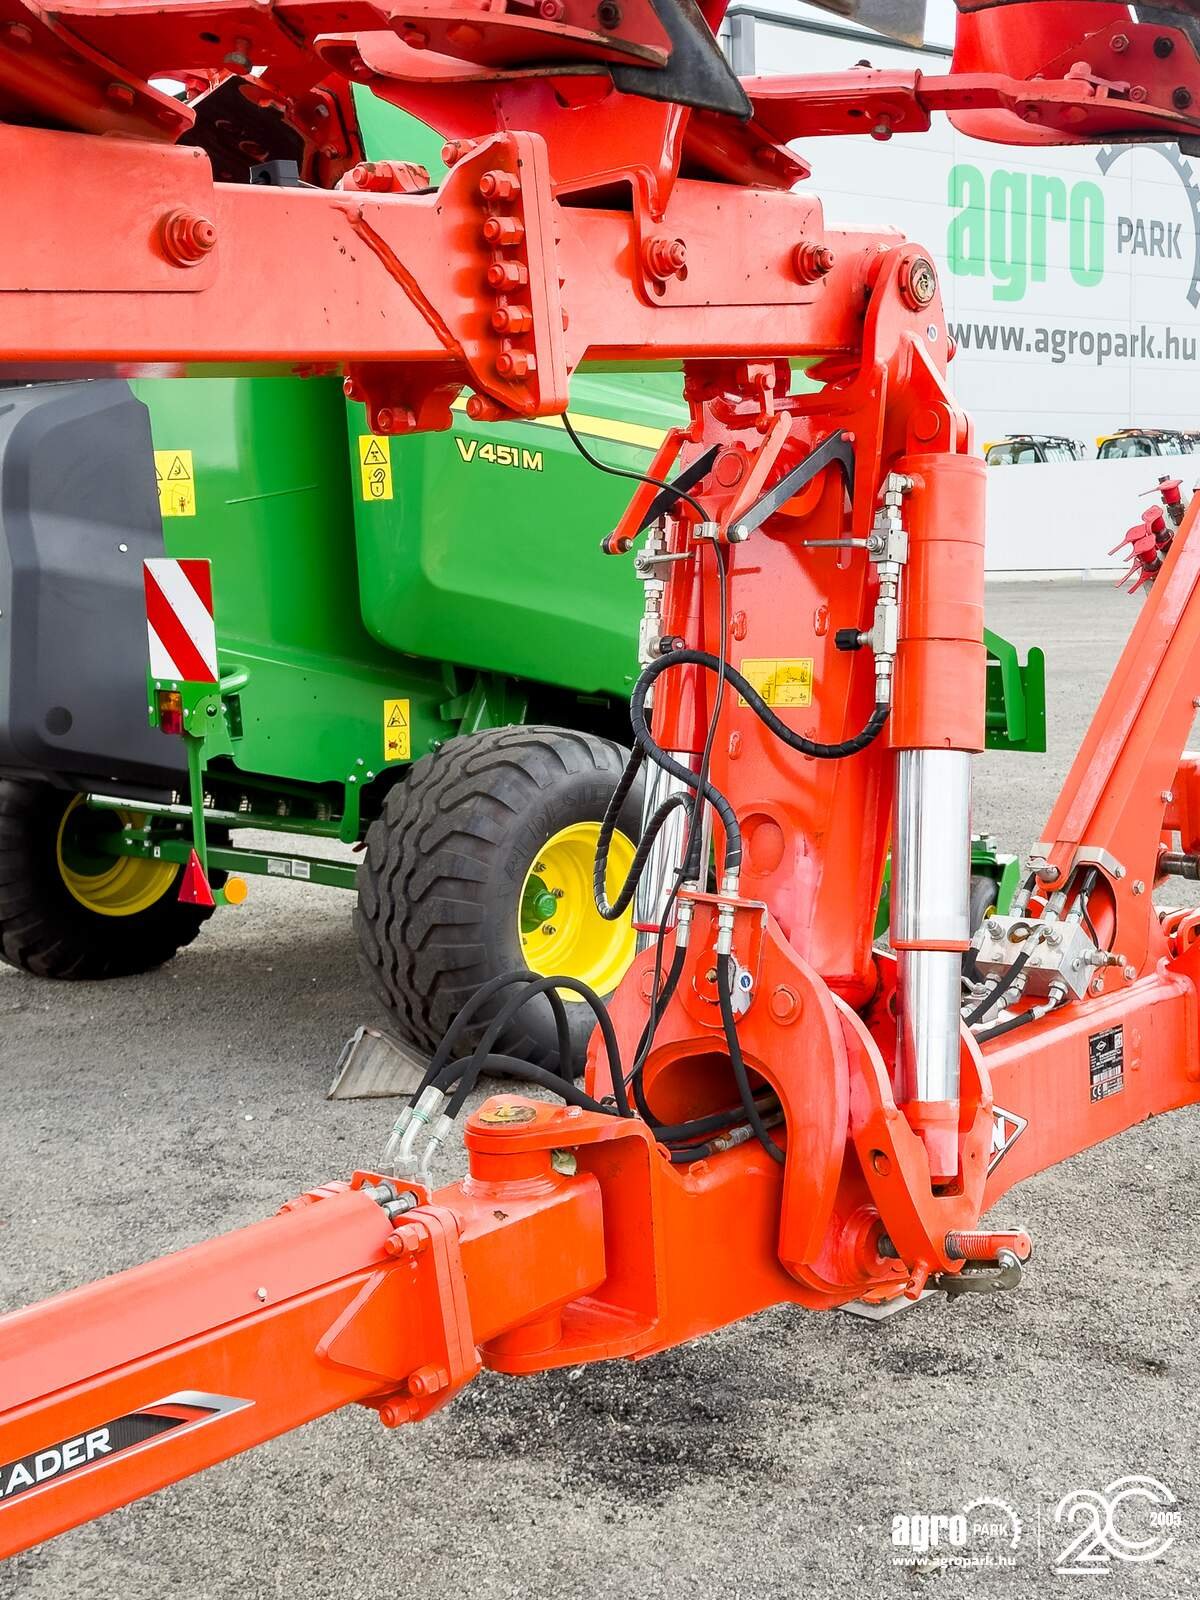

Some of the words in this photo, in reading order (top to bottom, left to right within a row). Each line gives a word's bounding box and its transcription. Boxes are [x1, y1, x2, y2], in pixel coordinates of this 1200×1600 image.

[947, 164, 1104, 302] agro
[1117, 216, 1182, 259] PARK
[947, 323, 1196, 366] www.agropark.hu
